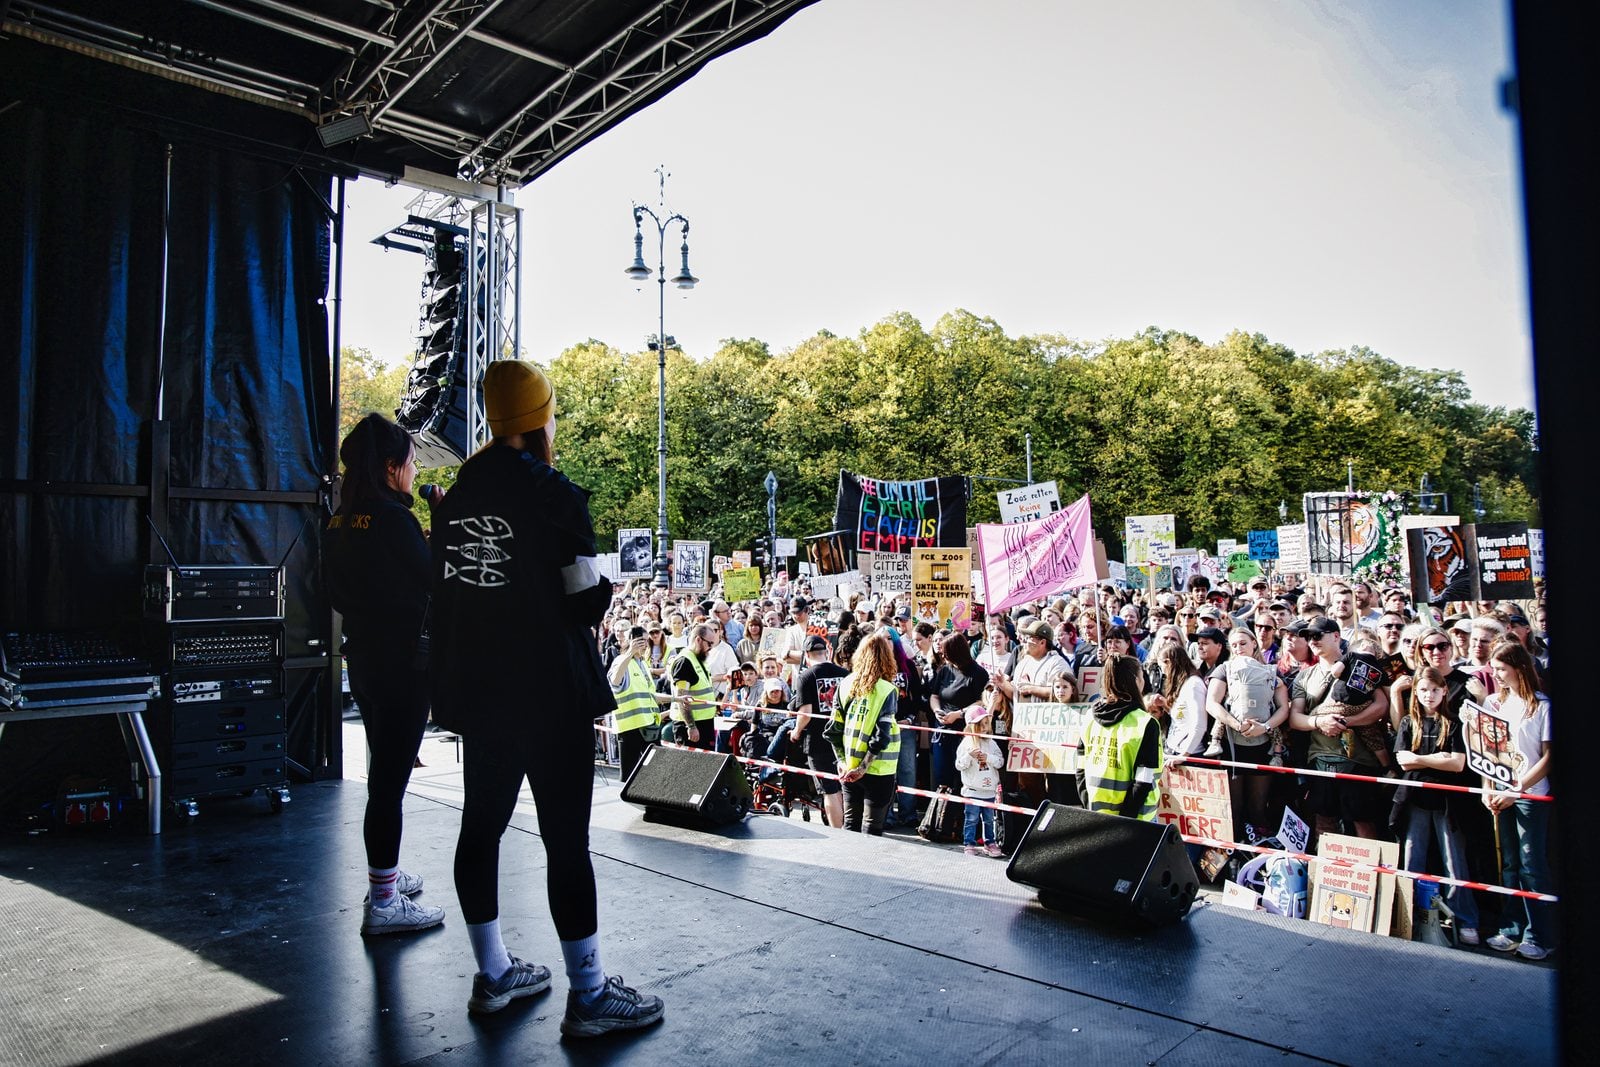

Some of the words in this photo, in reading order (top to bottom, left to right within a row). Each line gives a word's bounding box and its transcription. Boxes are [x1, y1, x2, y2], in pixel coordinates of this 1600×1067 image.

[860, 478, 934, 501] #UNTIL
[863, 495, 929, 519] EVERY
[863, 513, 918, 537] CAGE
[921, 518, 936, 539] IS
[1477, 536, 1507, 549] Warum
[1508, 533, 1527, 546] sind
[1479, 548, 1499, 560] deine
[1500, 546, 1530, 559] Gefühle
[873, 561, 909, 571] GITTER
[1484, 559, 1505, 570] mehr
[1505, 558, 1526, 570] wert
[1482, 570, 1497, 583] als
[1497, 568, 1531, 582] meine?
[915, 583, 938, 591] UNTIL
[940, 583, 964, 591] EVERY
[808, 613, 828, 628] FCK
[1040, 730, 1065, 743] NUR
[1470, 752, 1511, 783] ZOO
[1183, 795, 1205, 813] DIE
[1159, 813, 1222, 840] TIERE
[1356, 871, 1371, 882] SIE
